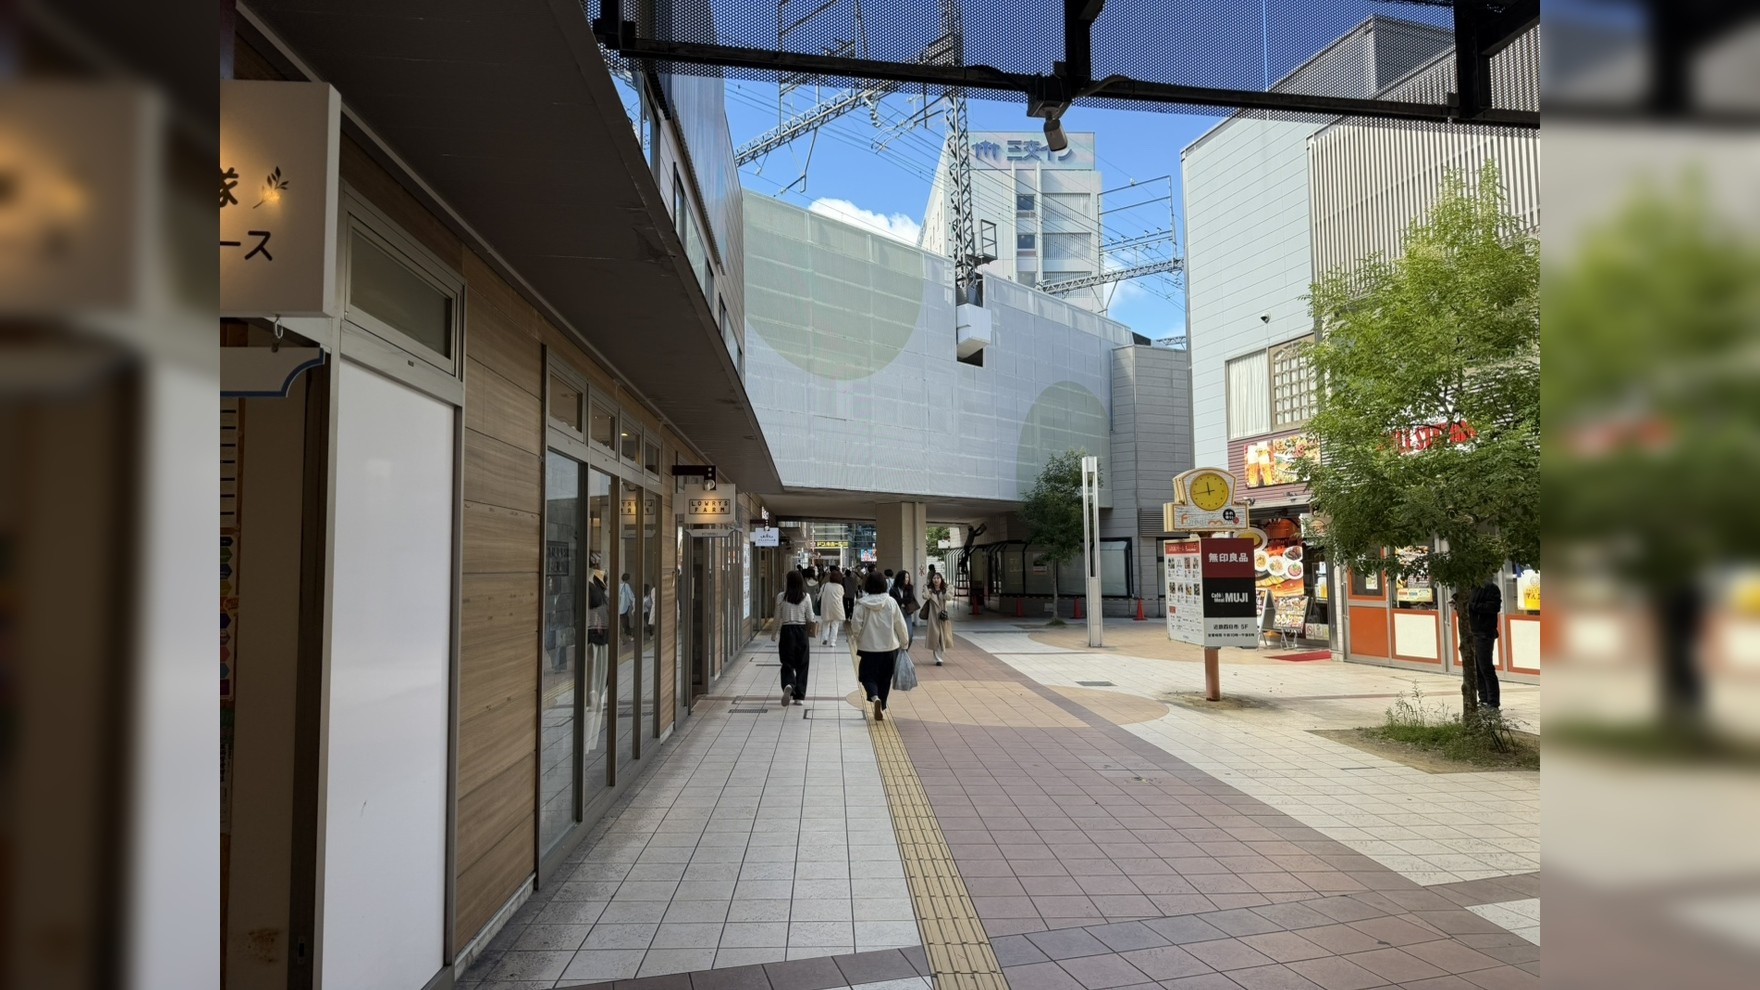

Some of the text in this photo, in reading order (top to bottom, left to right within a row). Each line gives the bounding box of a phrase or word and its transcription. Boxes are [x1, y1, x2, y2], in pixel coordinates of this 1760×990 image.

[1208, 552, 1249, 563] 無印良品
[1225, 592, 1249, 603] MUJI
